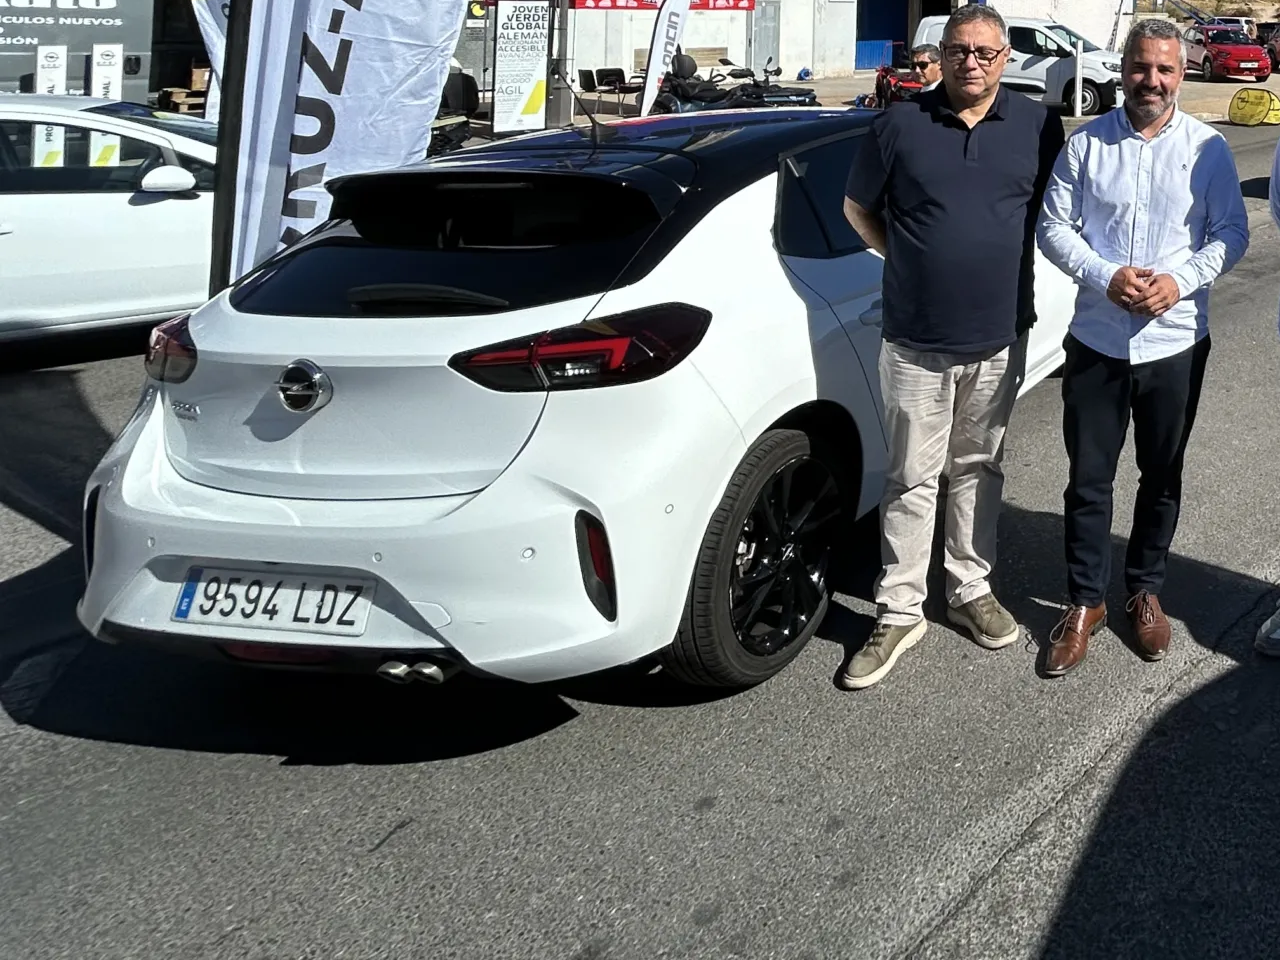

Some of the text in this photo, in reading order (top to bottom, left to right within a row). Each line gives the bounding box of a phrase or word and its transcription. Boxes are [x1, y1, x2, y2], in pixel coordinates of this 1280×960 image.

[512, 5, 549, 14] JOVEN
[0, 15, 124, 26] CULOS NUEVOS
[506, 13, 548, 22] VERDE
[501, 22, 547, 31] GLOBAL
[498, 51, 543, 59] AVANZADO
[199, 576, 365, 627] 9594 LDZ
